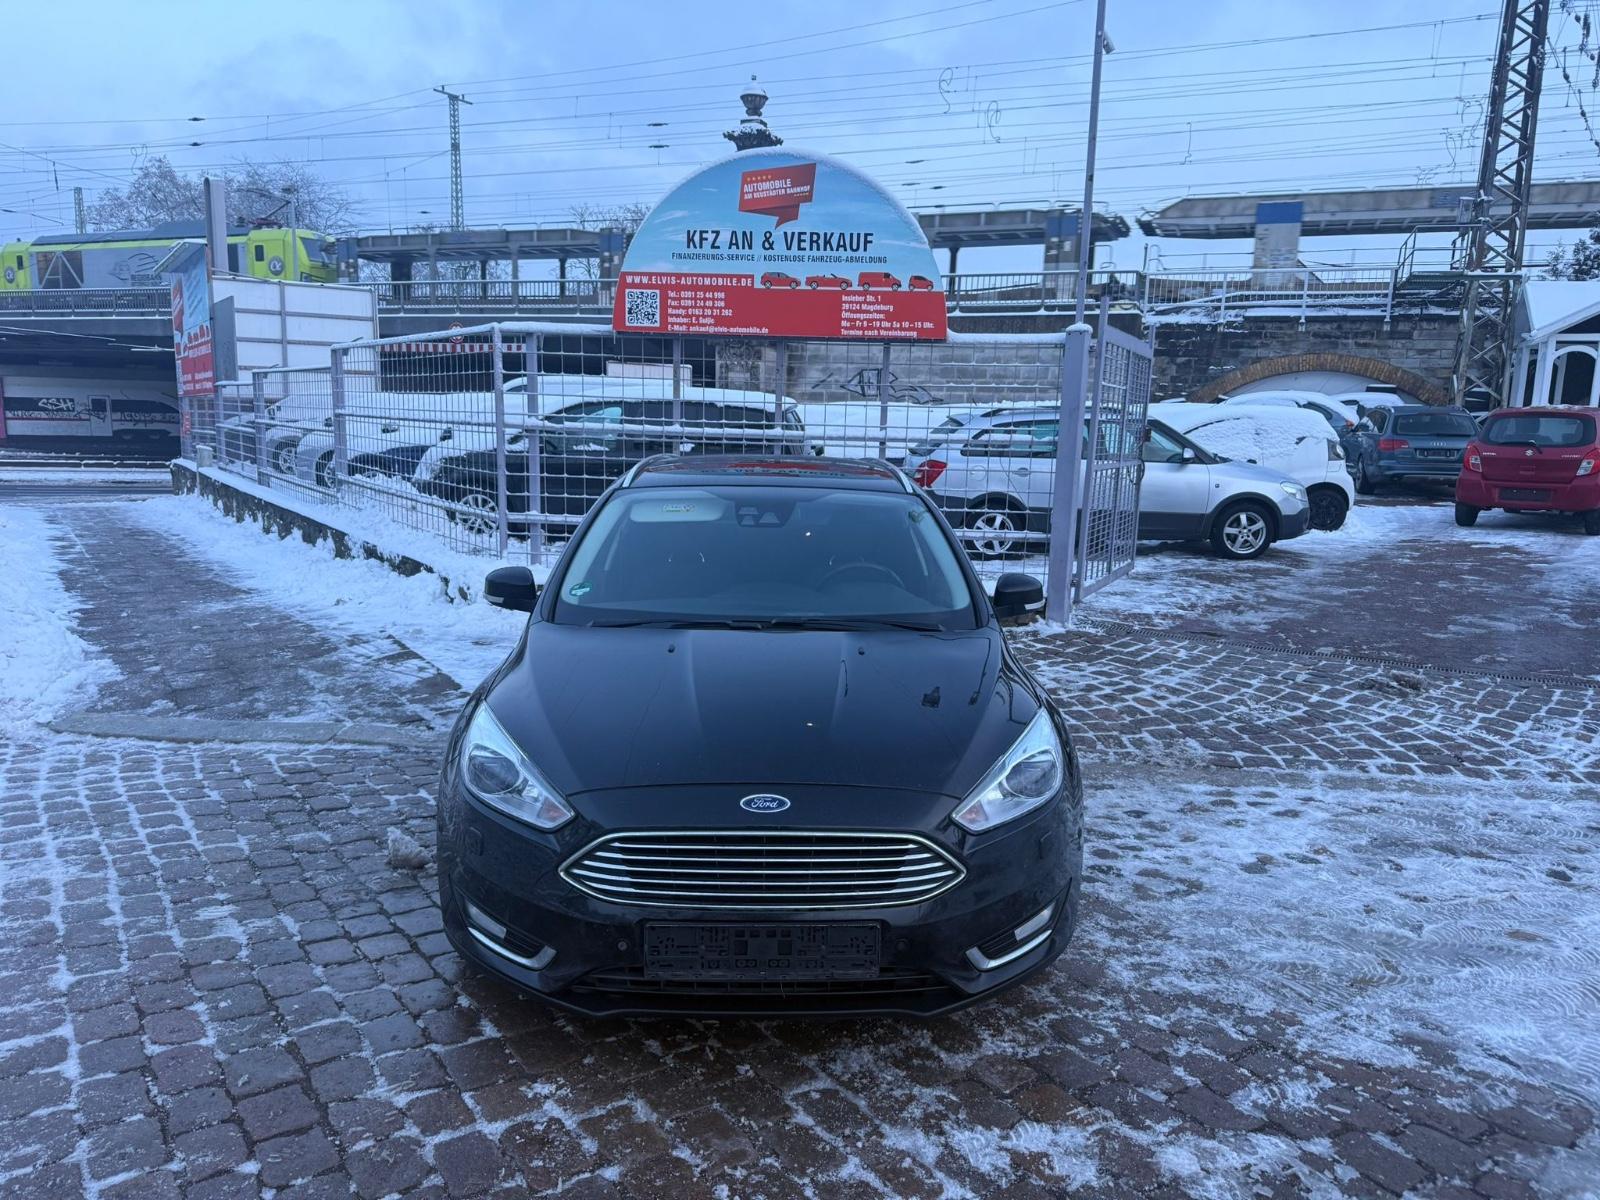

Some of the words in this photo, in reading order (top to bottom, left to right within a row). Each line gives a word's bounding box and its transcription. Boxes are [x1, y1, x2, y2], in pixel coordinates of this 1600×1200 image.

[743, 178, 792, 193] AUTOMOBILE
[753, 189, 786, 199] NEUSTÄDTER
[786, 185, 810, 194] BAHNHOF
[686, 229, 721, 250] KFZ
[728, 230, 753, 251] AN
[761, 230, 775, 251] &
[783, 231, 874, 252] VERKAUF
[671, 252, 756, 262] FINANZIERUNGS-SERVICE
[763, 254, 806, 263] KOSTENLOSE
[807, 255, 888, 264] FAHRZEUG-ABMELDUNG
[625, 275, 753, 287] WWW.ELVIS-AUTOMOBILE.DE
[696, 291, 704, 299] 25
[705, 291, 713, 299] 44
[667, 299, 680, 307] Fax:
[696, 300, 704, 308] 24
[861, 303, 894, 312] Magdeburg
[667, 307, 688, 316] Handy:
[704, 308, 712, 316] 20
[712, 308, 721, 317] 31
[692, 316, 698, 324] E.
[667, 324, 688, 332] E-Mail:
[841, 328, 864, 336] Termine
[864, 329, 879, 337] nach
[879, 329, 918, 338] Vereinbarung
[751, 797, 779, 808] Ford
